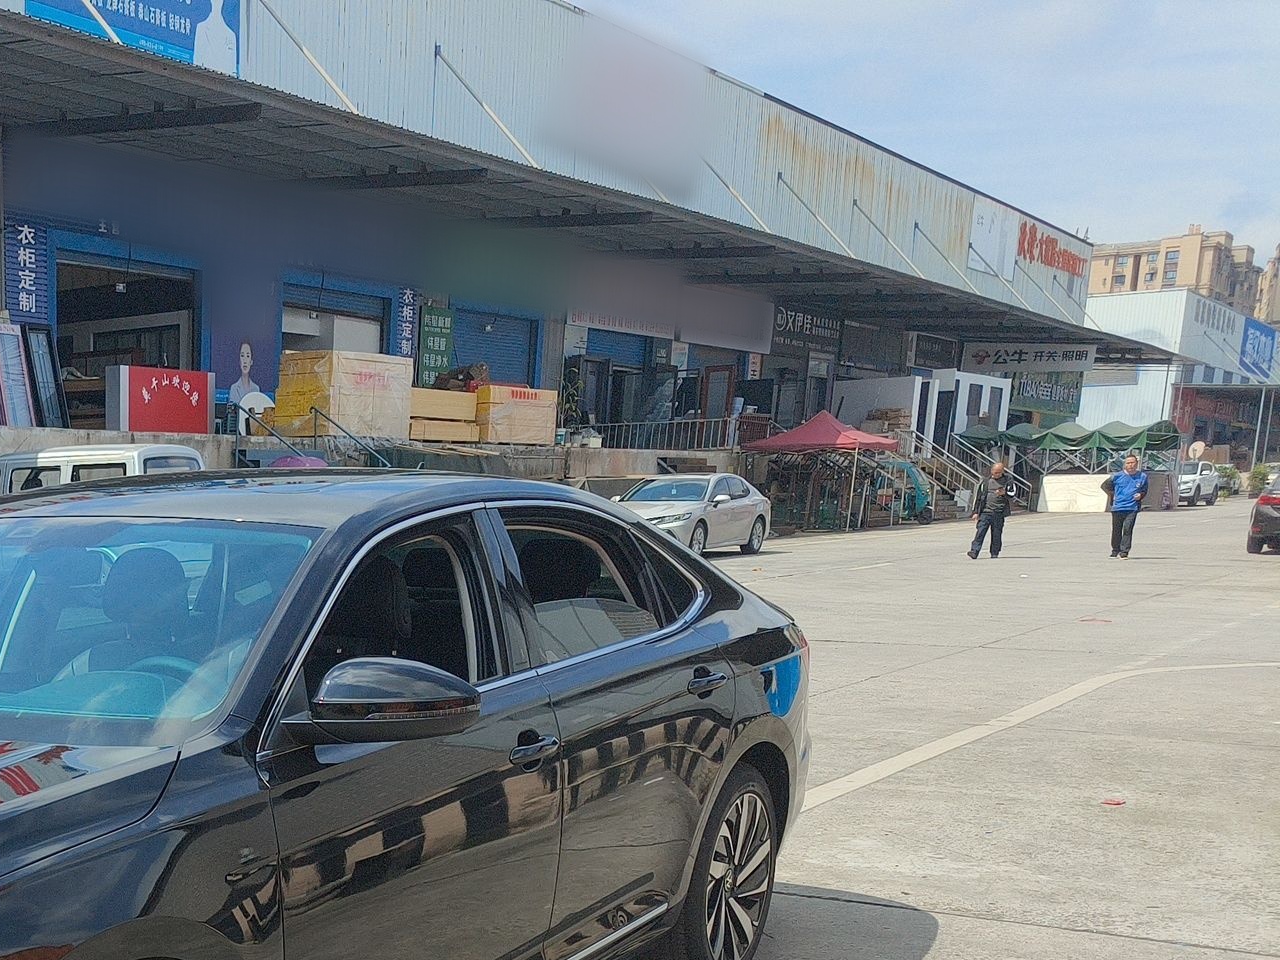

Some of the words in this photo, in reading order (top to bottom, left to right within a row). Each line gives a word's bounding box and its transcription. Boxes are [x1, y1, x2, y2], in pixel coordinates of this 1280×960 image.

[17, 224, 36, 313] 衣柜定制
[401, 287, 415, 355] 衣柜定制
[427, 336, 447, 351] 伟星管
[423, 353, 449, 368] 伟星净水
[992, 349, 1028, 365] 公牛
[1033, 350, 1089, 362] 开关·照明
[422, 371, 439, 385] 伟星
